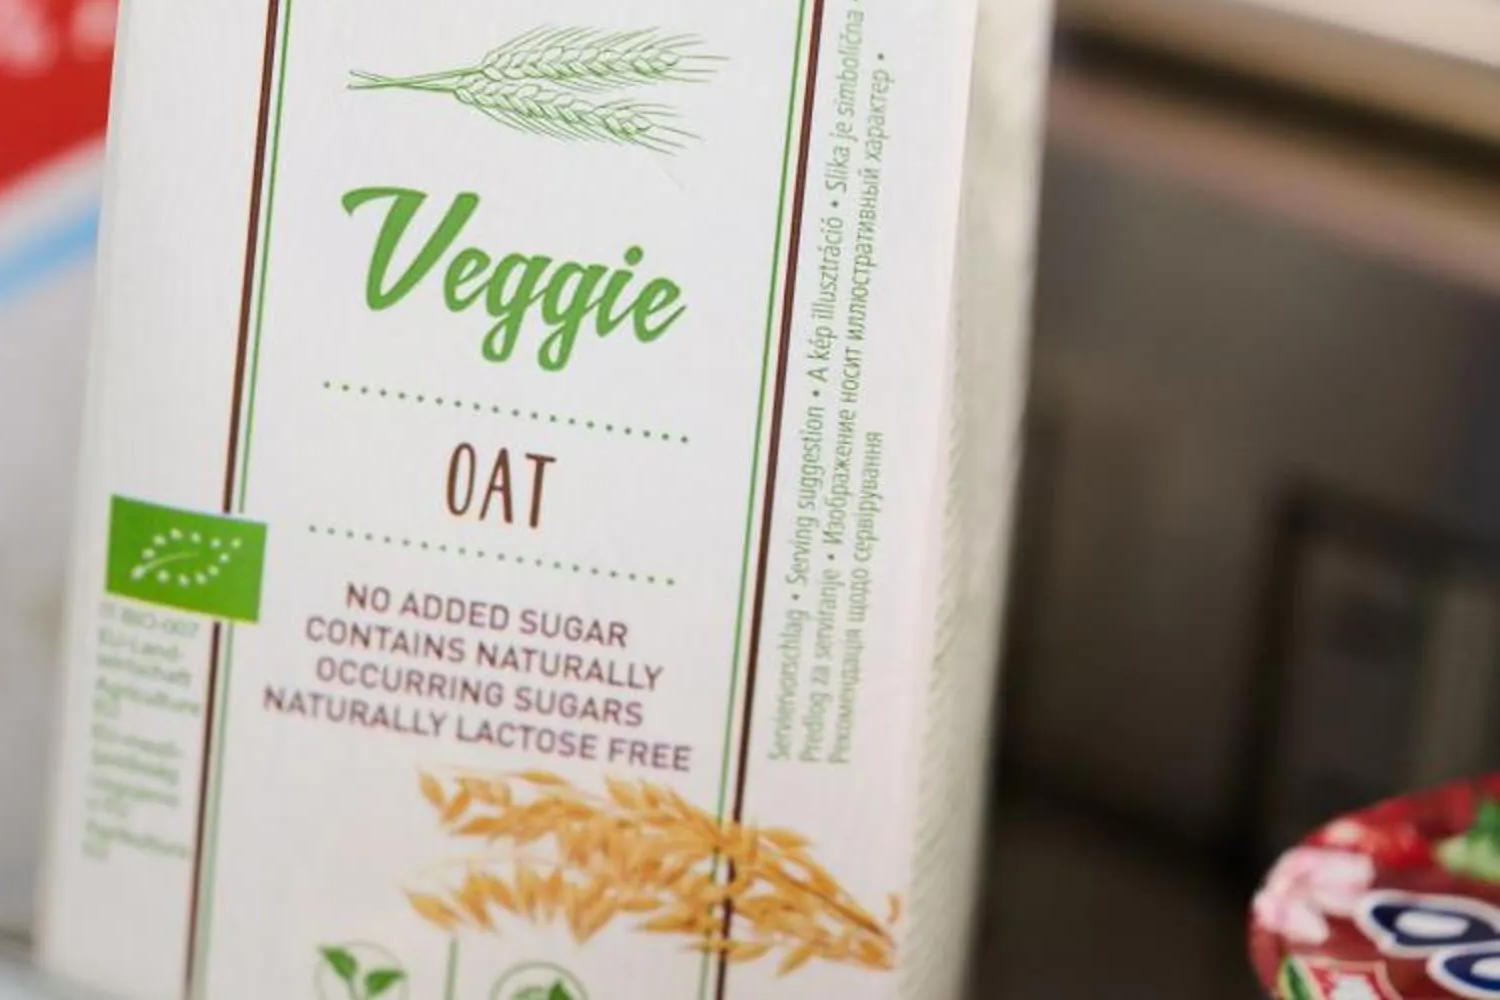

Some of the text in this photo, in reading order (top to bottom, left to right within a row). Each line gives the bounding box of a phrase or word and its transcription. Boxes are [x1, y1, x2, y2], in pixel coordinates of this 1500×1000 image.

[831, 119, 858, 143] je
[825, 145, 852, 193] Slika
[340, 186, 687, 372] Veggie
[822, 408, 857, 546] Изображение
[842, 346, 864, 404] носит
[863, 69, 895, 162] характер
[807, 366, 829, 384] A
[447, 442, 557, 529] OAT
[797, 406, 826, 511] suggestion
[786, 514, 816, 587] Serving
[345, 582, 629, 648] NO ADDED SUGAR
[305, 616, 664, 692] CONTAINS NATURALLY
[768, 609, 808, 763] Serviervorschlag
[263, 685, 692, 772] NATURALLY LACTOSE FREE
[315, 656, 644, 728] OCCURRING SUGARS
[799, 692, 828, 764] Predlog
